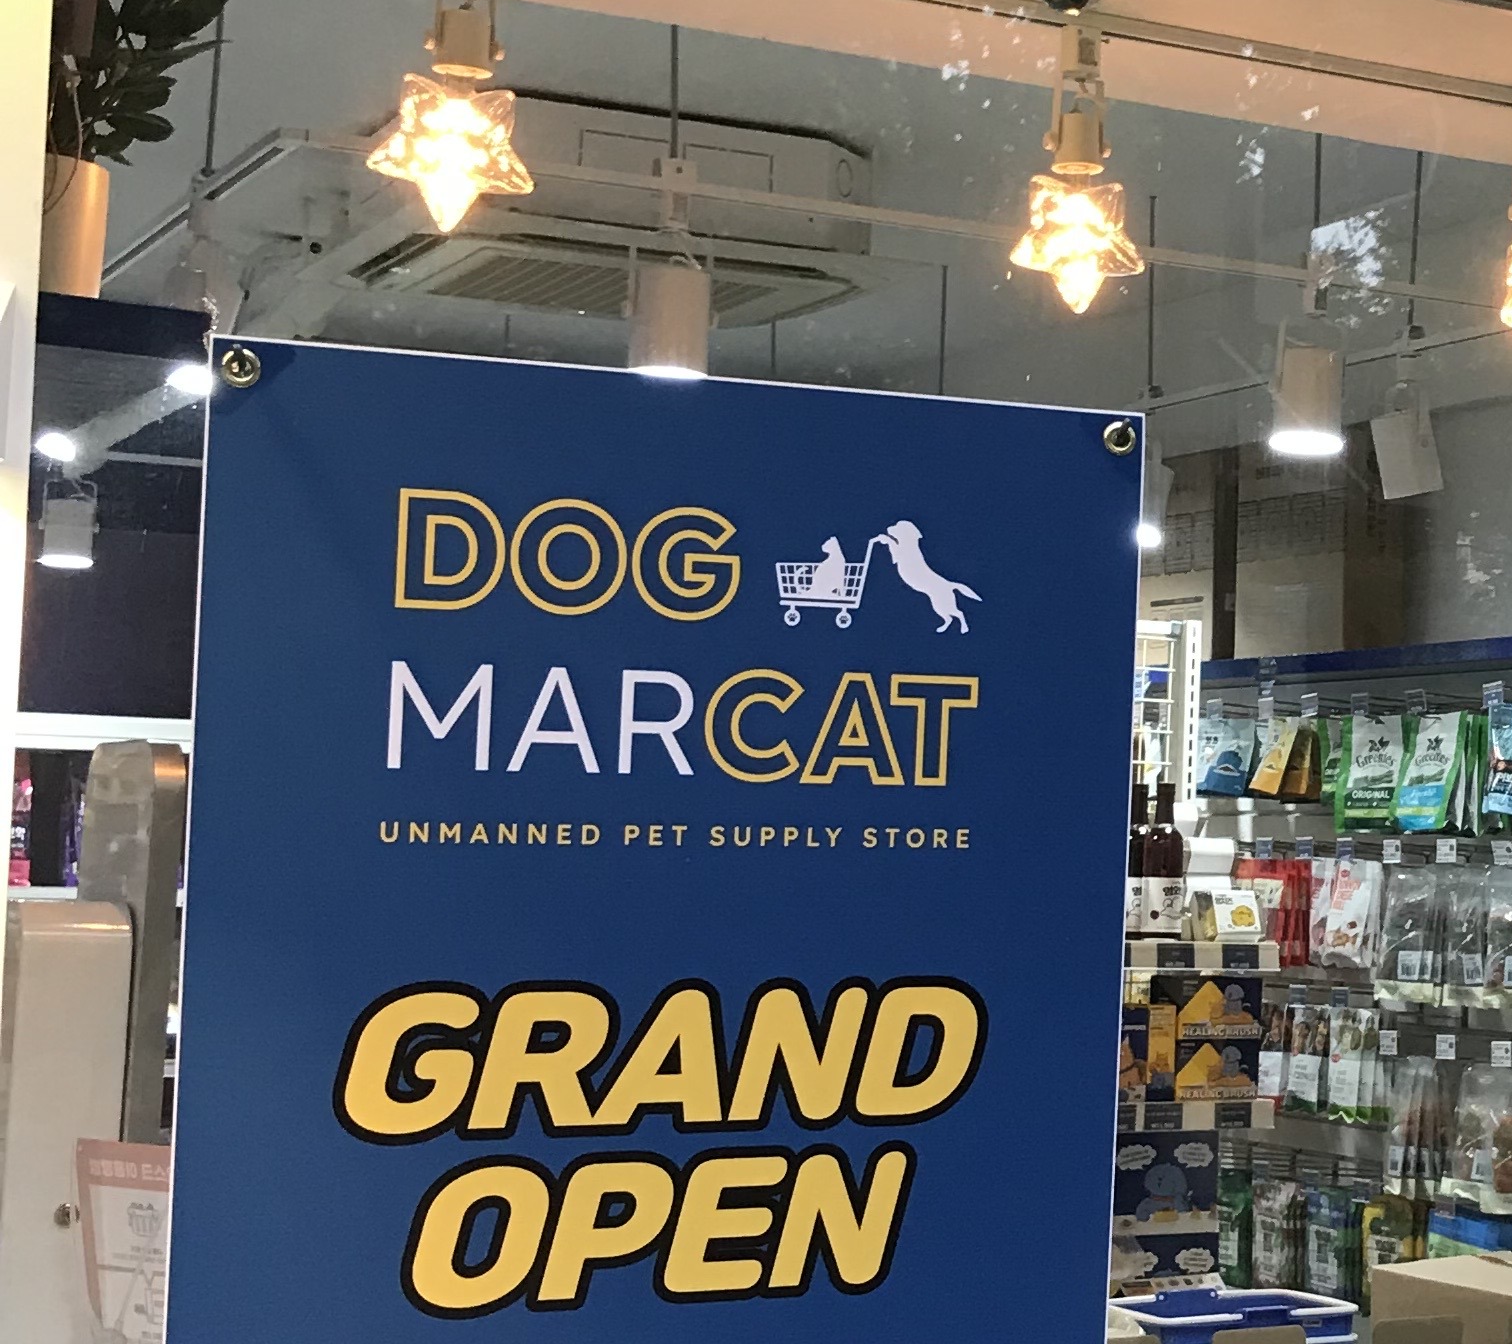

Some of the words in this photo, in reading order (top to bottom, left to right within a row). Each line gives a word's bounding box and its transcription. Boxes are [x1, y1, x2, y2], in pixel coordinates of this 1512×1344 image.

[394, 487, 741, 622] DOG
[386, 659, 979, 787] MARCAT
[378, 820, 602, 847] UNMANNED
[624, 824, 688, 848] PET
[708, 825, 842, 850] SUPPLY
[862, 827, 972, 850] STORE
[341, 983, 984, 1138] GRAND
[408, 1148, 910, 1312] OPEN
